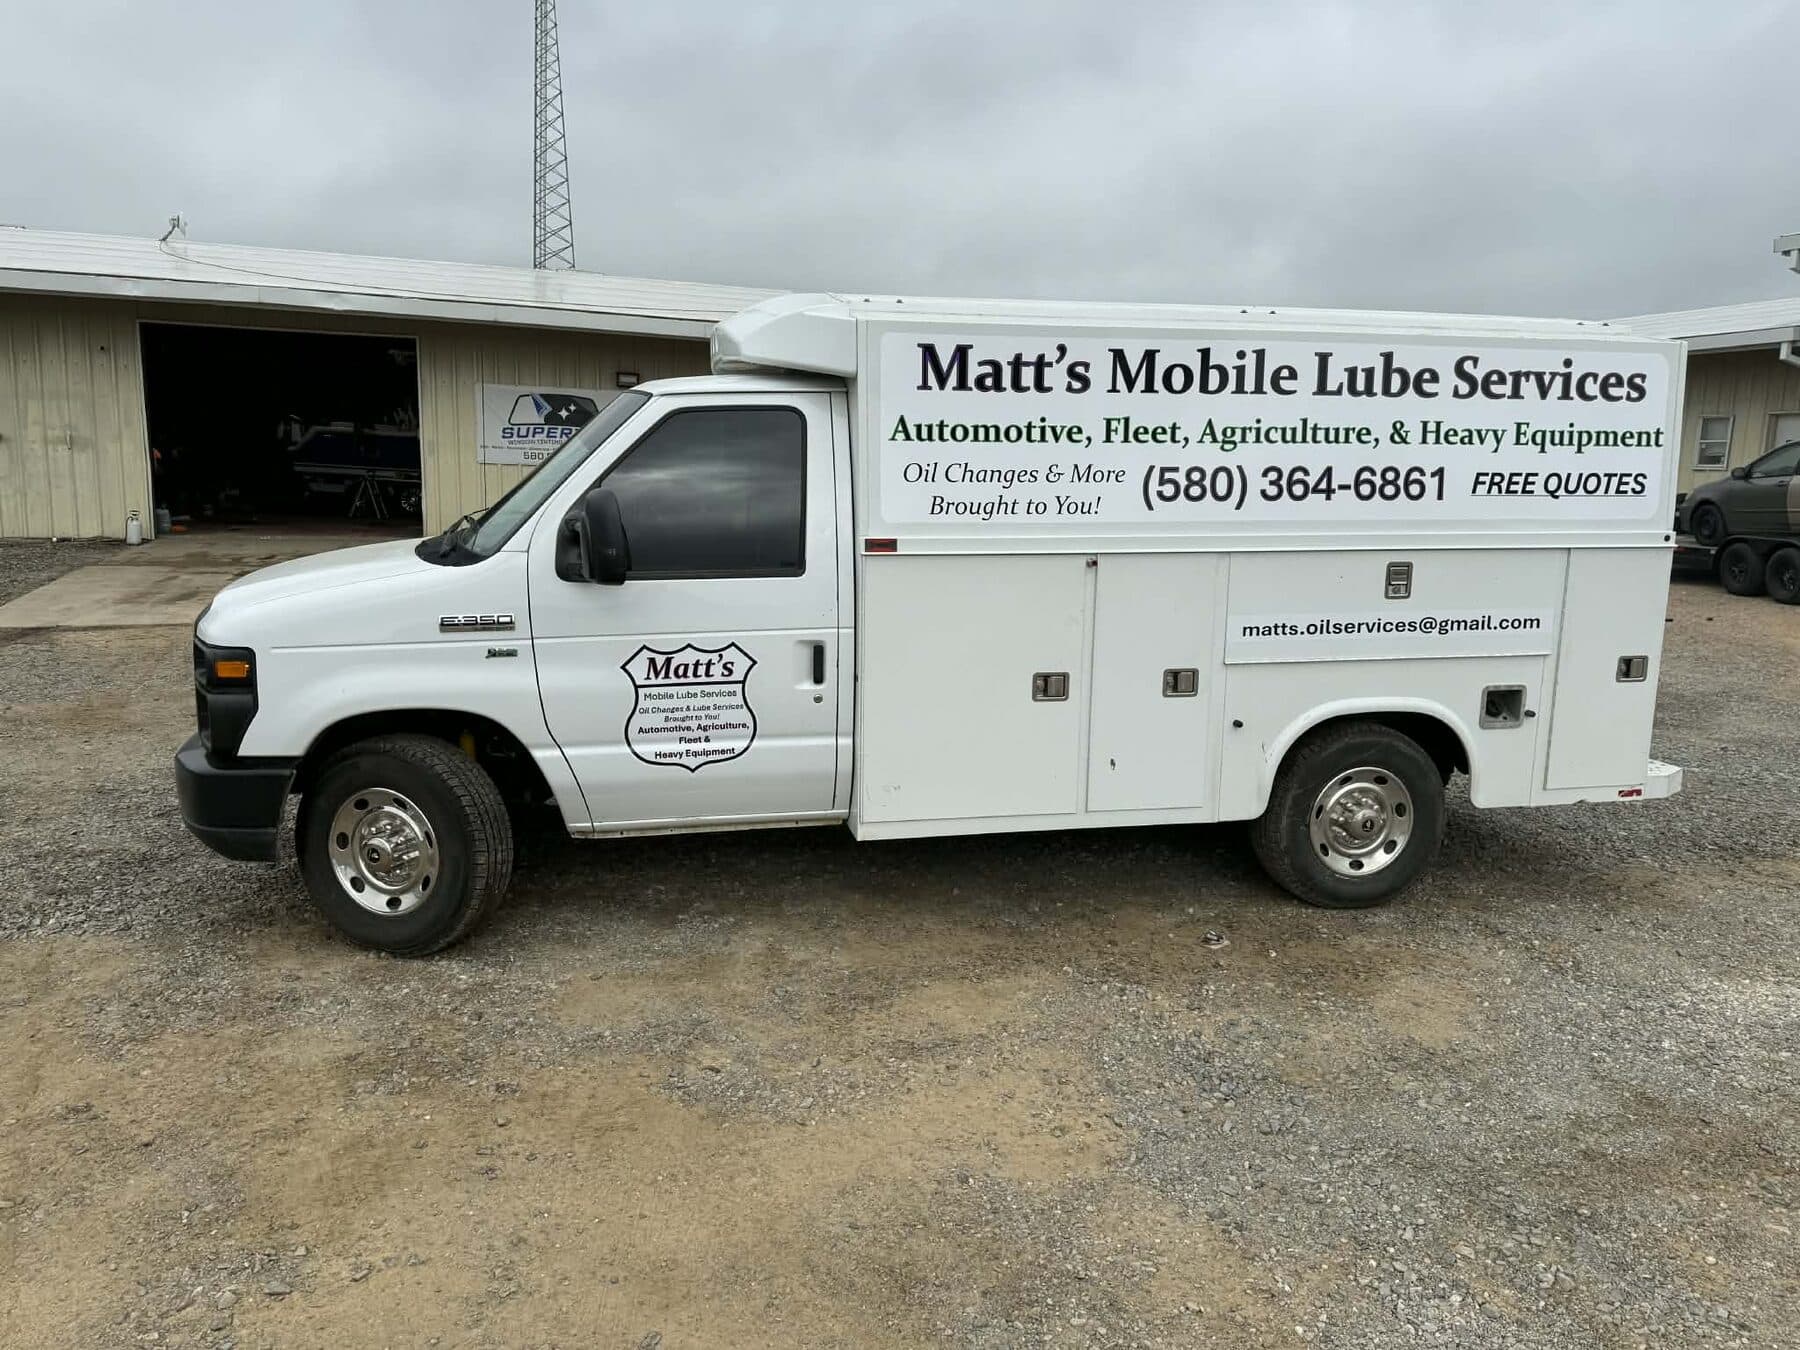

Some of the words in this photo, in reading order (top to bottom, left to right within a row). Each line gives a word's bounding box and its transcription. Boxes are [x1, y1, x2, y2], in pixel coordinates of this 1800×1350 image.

[916, 343, 1092, 394] Matt's
[1106, 347, 1298, 395] Mobile
[1312, 351, 1440, 399] Lube
[1452, 355, 1648, 403] Services
[501, 426, 578, 439] SUPER
[888, 414, 1093, 448] Automotive,
[1102, 416, 1191, 448] Fleet,
[1196, 416, 1380, 452] Agriculture,
[1389, 420, 1411, 445] &
[1420, 420, 1507, 453] Heavy
[1514, 422, 1664, 454] Equipment
[903, 462, 937, 483] Oil
[944, 462, 1039, 489] Changes
[1045, 464, 1064, 483] &
[1070, 463, 1126, 483] More
[1471, 472, 1538, 495] FREE
[1543, 472, 1648, 500] QUOTES
[1141, 464, 1248, 511] (580)
[1260, 465, 1446, 502] 364-6861
[929, 495, 1019, 521] Brought
[1025, 498, 1048, 516] to
[1055, 495, 1102, 516] You!
[1242, 615, 1541, 637] matts.oilservices@gmail.com
[644, 653, 735, 680] Matt's
[644, 691, 675, 701] Mobile
[676, 691, 698, 699] Lube
[700, 689, 737, 698] Services
[651, 706, 684, 714] Changes
[692, 704, 711, 712] Lube
[664, 715, 694, 723] Brought
[637, 724, 695, 735] Automotive,
[696, 722, 750, 732] Agriculture,
[679, 736, 702, 744] Fleet
[654, 750, 684, 759] Heavy
[685, 747, 736, 758] Equipment
